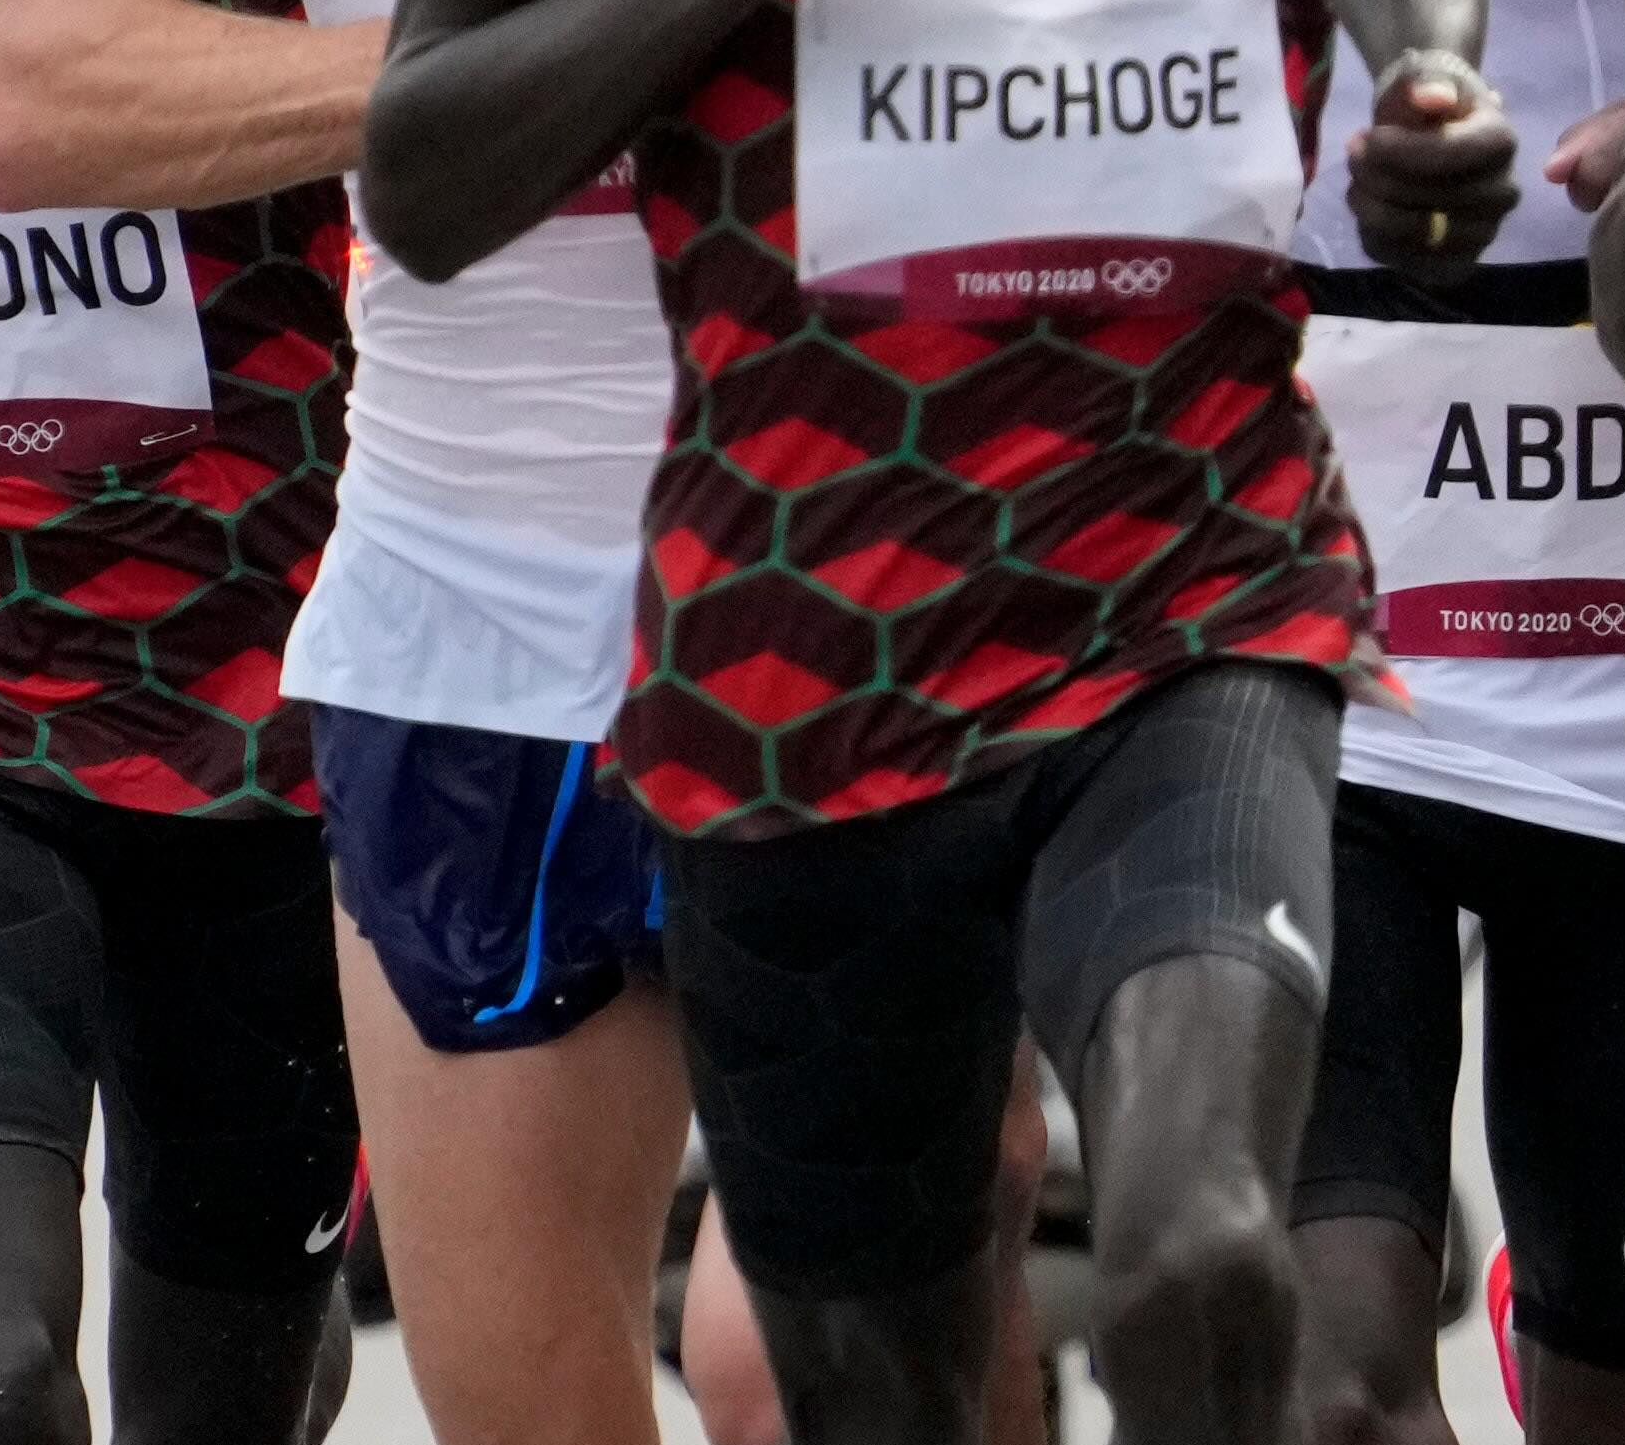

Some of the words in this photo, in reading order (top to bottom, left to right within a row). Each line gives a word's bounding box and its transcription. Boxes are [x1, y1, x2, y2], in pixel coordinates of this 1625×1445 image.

[859, 47, 1240, 143] KIPCHOGE
[955, 270, 1033, 297] TOKYO
[1037, 267, 1095, 294] 2020
[1439, 609, 1514, 632] TOKYO
[1518, 612, 1571, 633] 2020
